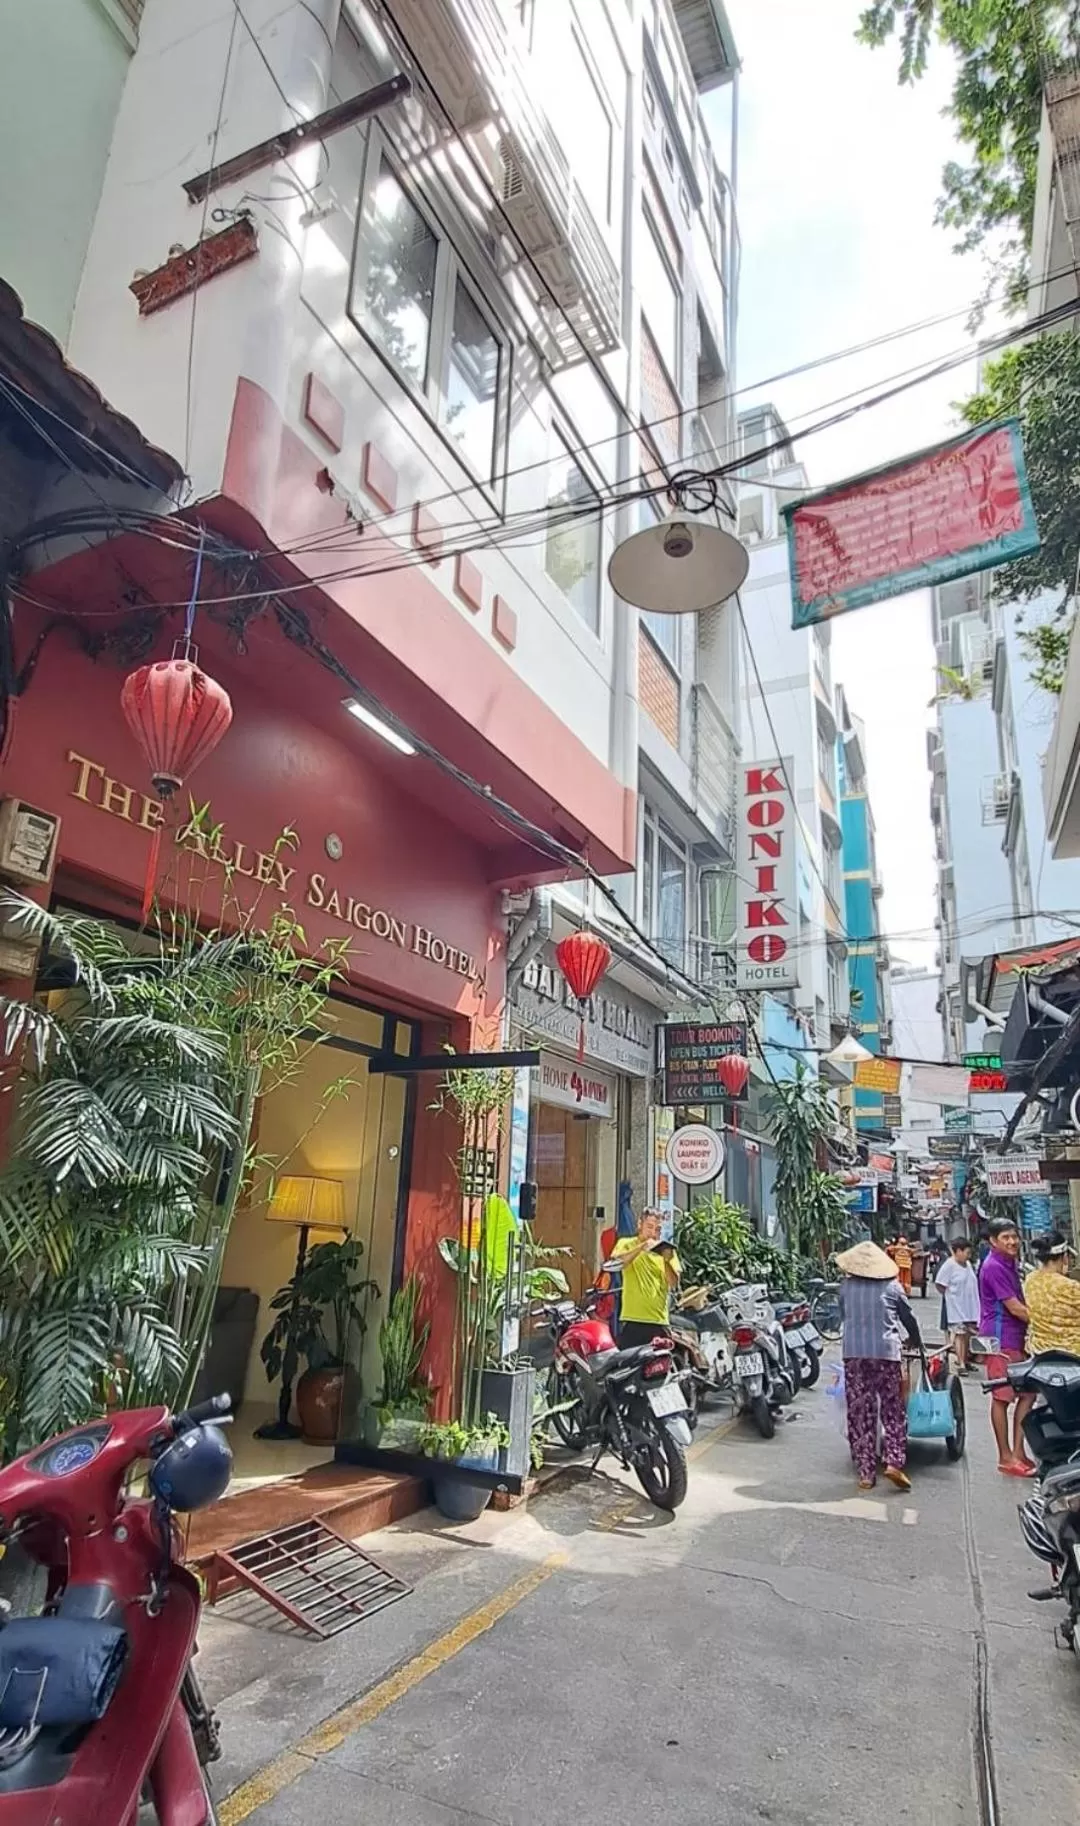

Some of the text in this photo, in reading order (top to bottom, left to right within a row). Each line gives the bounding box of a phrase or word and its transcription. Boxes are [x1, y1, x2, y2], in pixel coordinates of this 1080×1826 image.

[68, 751, 480, 981] THE ALLEY SAIGON HOTEL
[744, 766, 789, 963] KONIKO
[745, 966, 789, 980] HOTEL
[698, 1027, 742, 1043] BOOKING
[543, 1065, 568, 1091] HOME
[677, 1150, 711, 1158] LAUNDRY
[990, 1170, 1043, 1185] TRAVEL AGENC
